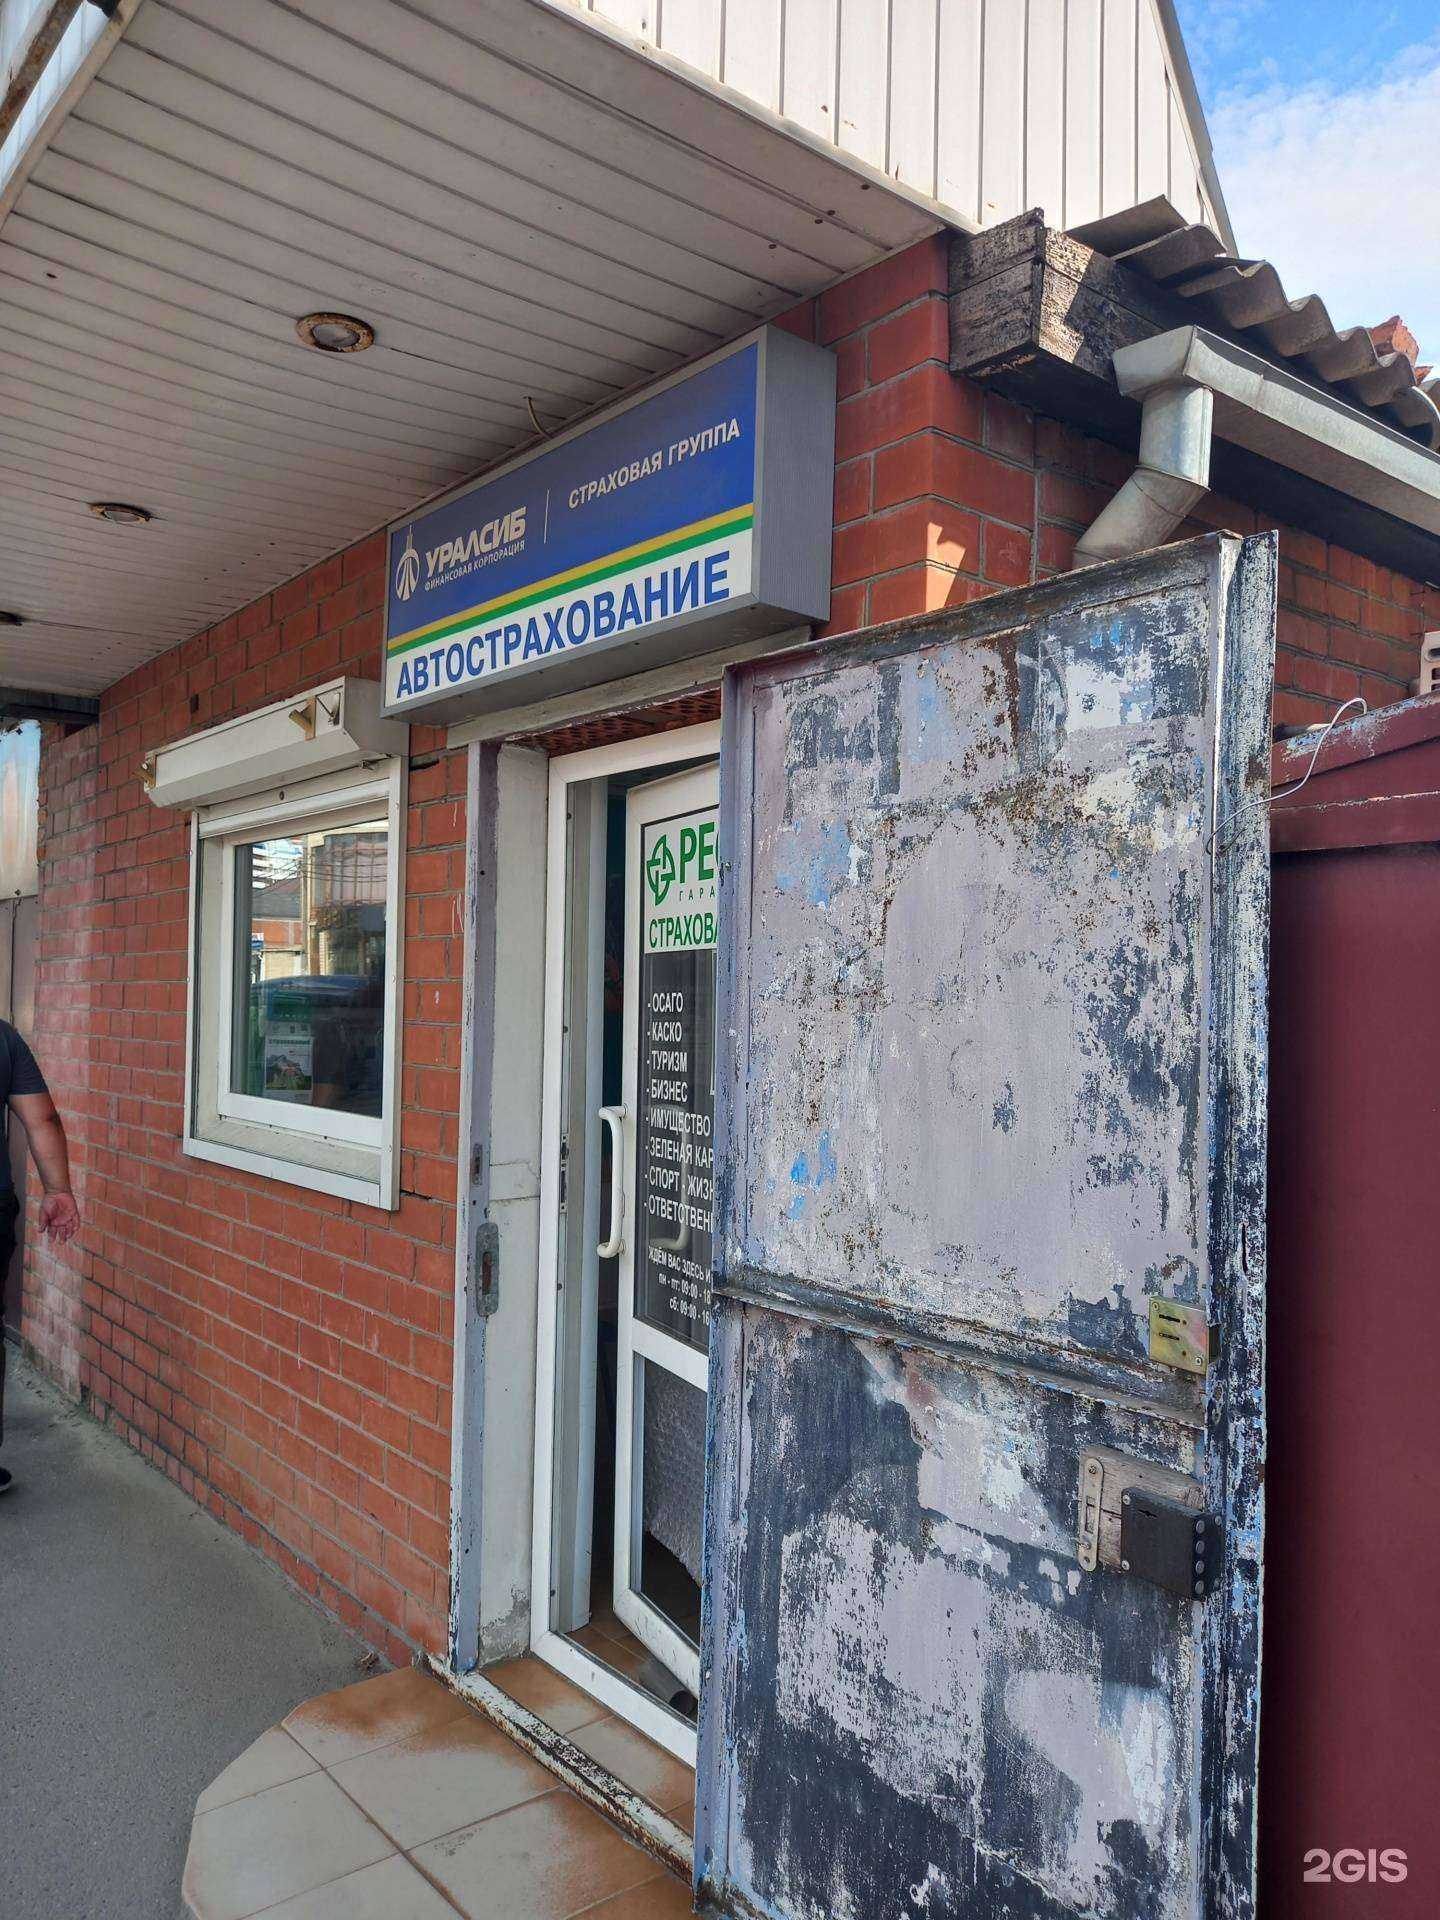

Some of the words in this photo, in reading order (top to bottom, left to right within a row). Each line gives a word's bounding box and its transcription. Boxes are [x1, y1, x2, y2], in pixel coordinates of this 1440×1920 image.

[568, 451, 663, 509] СТРАХОВАЯ
[668, 417, 741, 466] ГРУППА
[426, 506, 527, 578] УРАЛСИБ
[424, 566, 473, 592] ФИНАНСОВАЯ
[473, 540, 525, 573] КОРПОРАЦИЯ
[396, 550, 730, 699] АВТОСТРАХОВАНИЕ
[680, 822, 719, 884] РЕ
[652, 992, 684, 1012] ОСАГО
[652, 1021, 682, 1042] КАСКО
[651, 1050, 688, 1072] ТУРИЗМ
[651, 1079, 688, 1102] БИЗНЕС
[650, 1108, 711, 1137] ИМУЩЕСТВО
[649, 1136, 693, 1165] ЗЕЛЕНАЯ
[649, 1165, 680, 1192] СПОРТ
[668, 1253, 681, 1271] ВАС
[682, 1259, 705, 1280] ЗДЕСЬ
